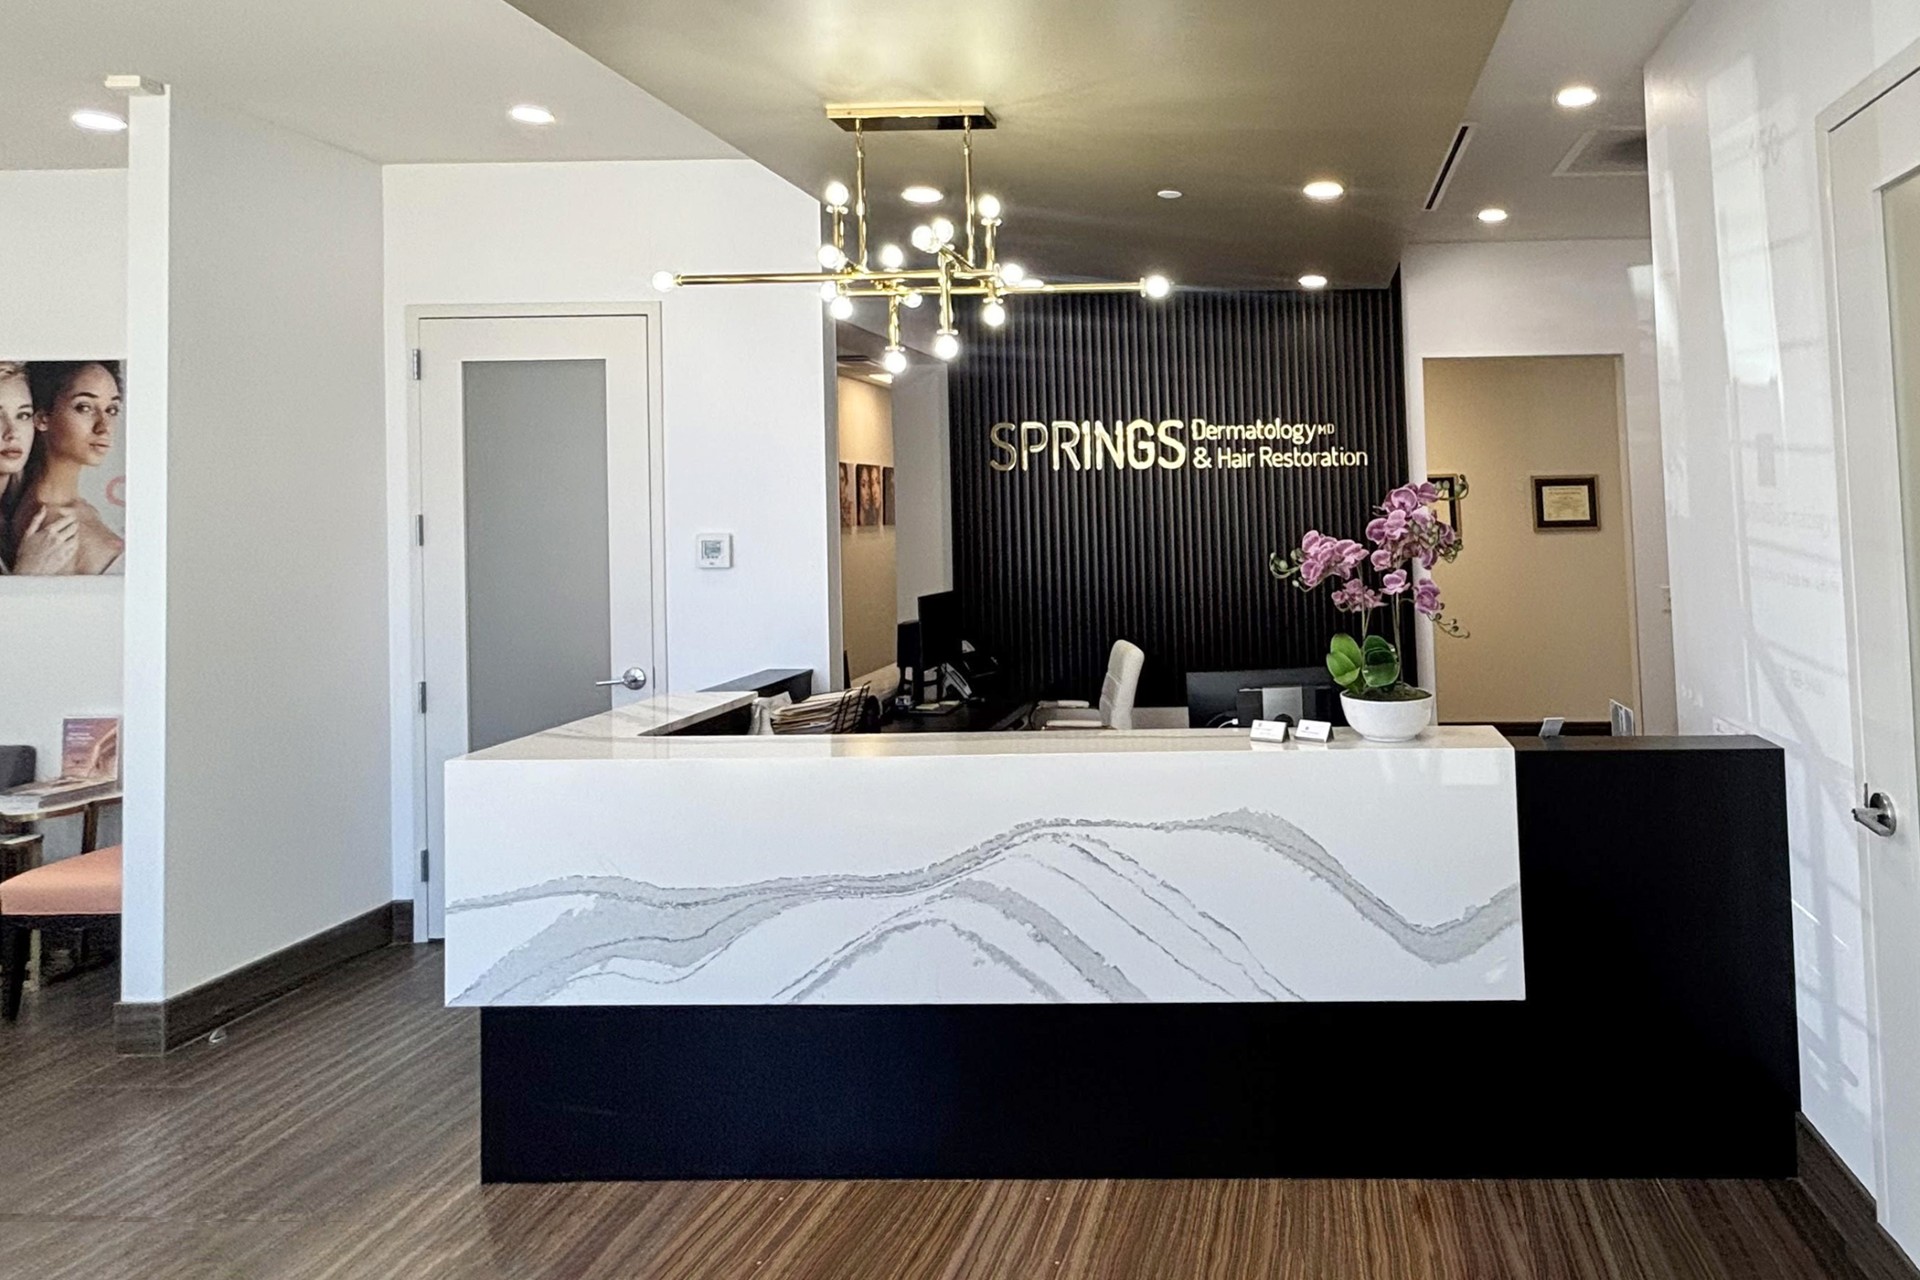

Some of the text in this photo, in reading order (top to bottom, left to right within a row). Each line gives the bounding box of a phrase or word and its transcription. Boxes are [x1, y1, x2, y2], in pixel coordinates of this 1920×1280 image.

[1191, 418, 1316, 445] Dermatology
[989, 419, 1186, 472] SPRINGS
[1191, 446, 1368, 469] & Hair Restoration
